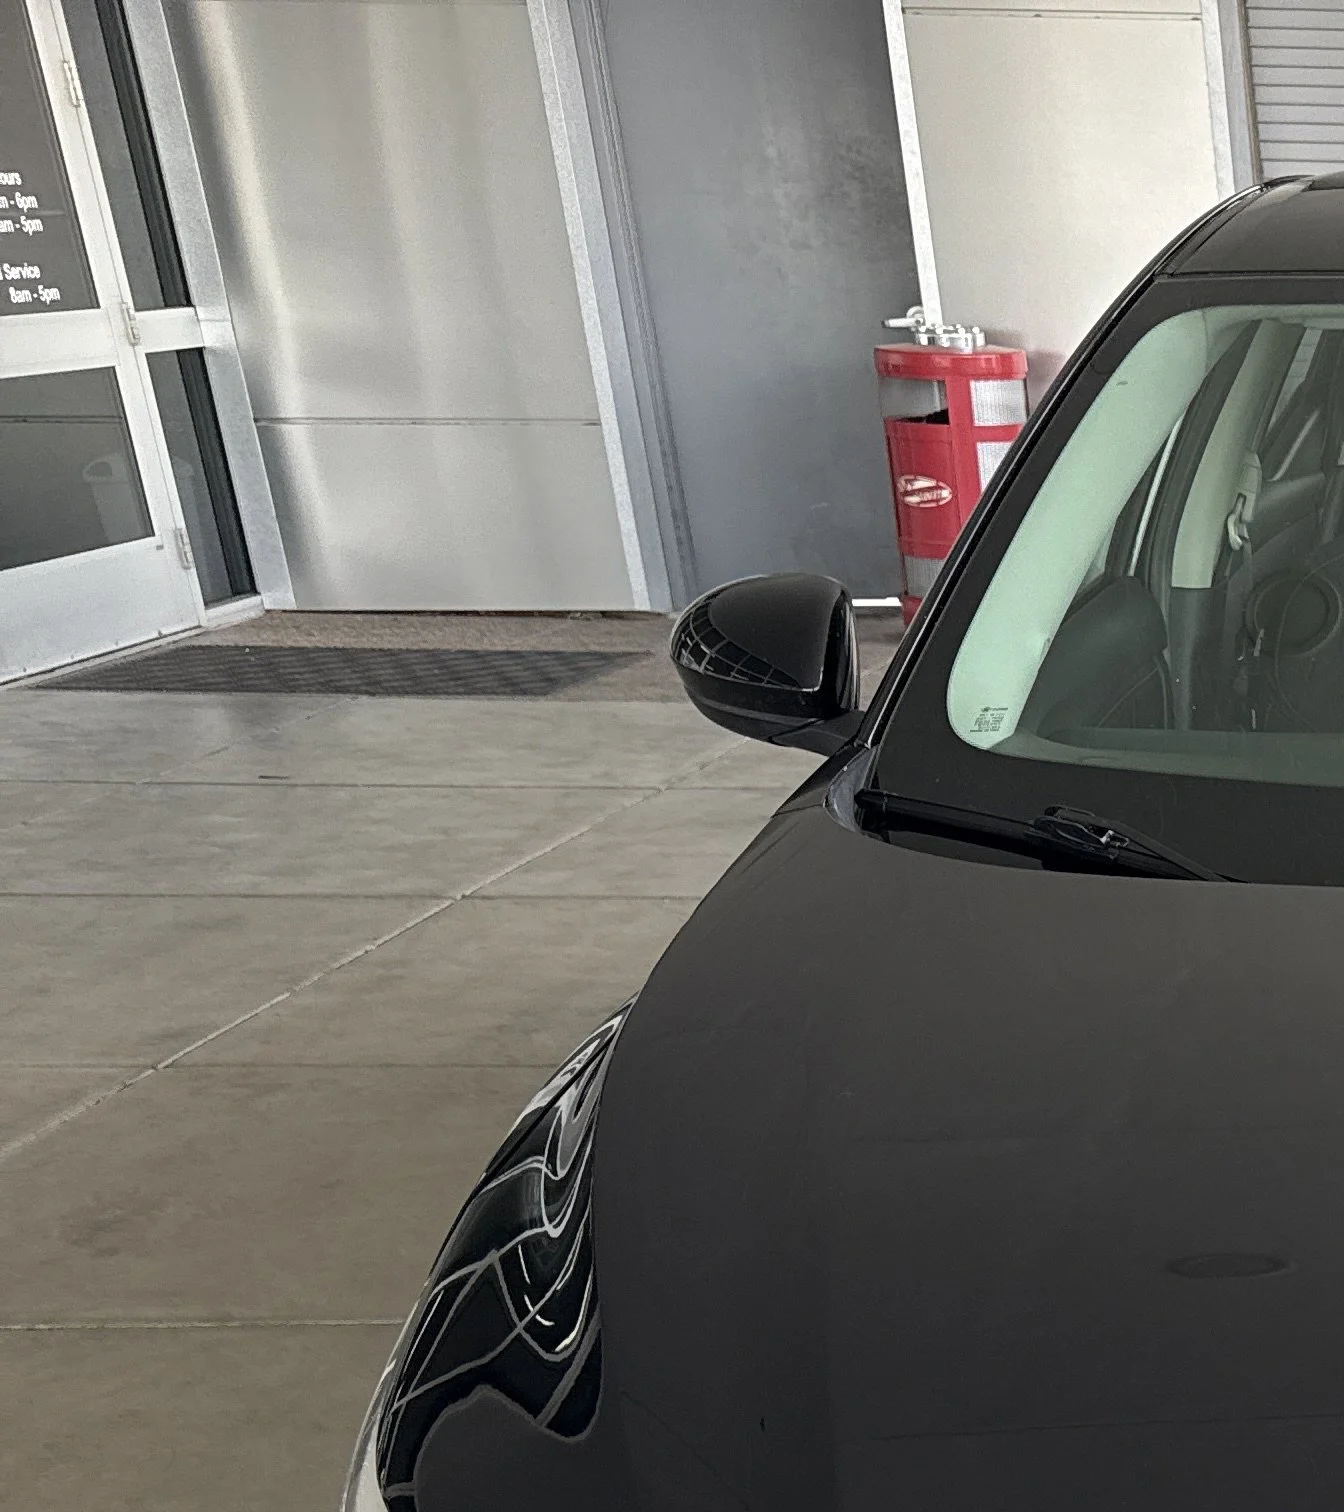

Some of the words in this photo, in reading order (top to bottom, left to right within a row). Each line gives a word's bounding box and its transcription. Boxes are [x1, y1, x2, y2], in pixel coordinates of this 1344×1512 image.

[15, 192, 38, 213] 6pm
[20, 215, 44, 236] 5pm
[3, 262, 41, 281] Service
[38, 284, 61, 306] 5pm
